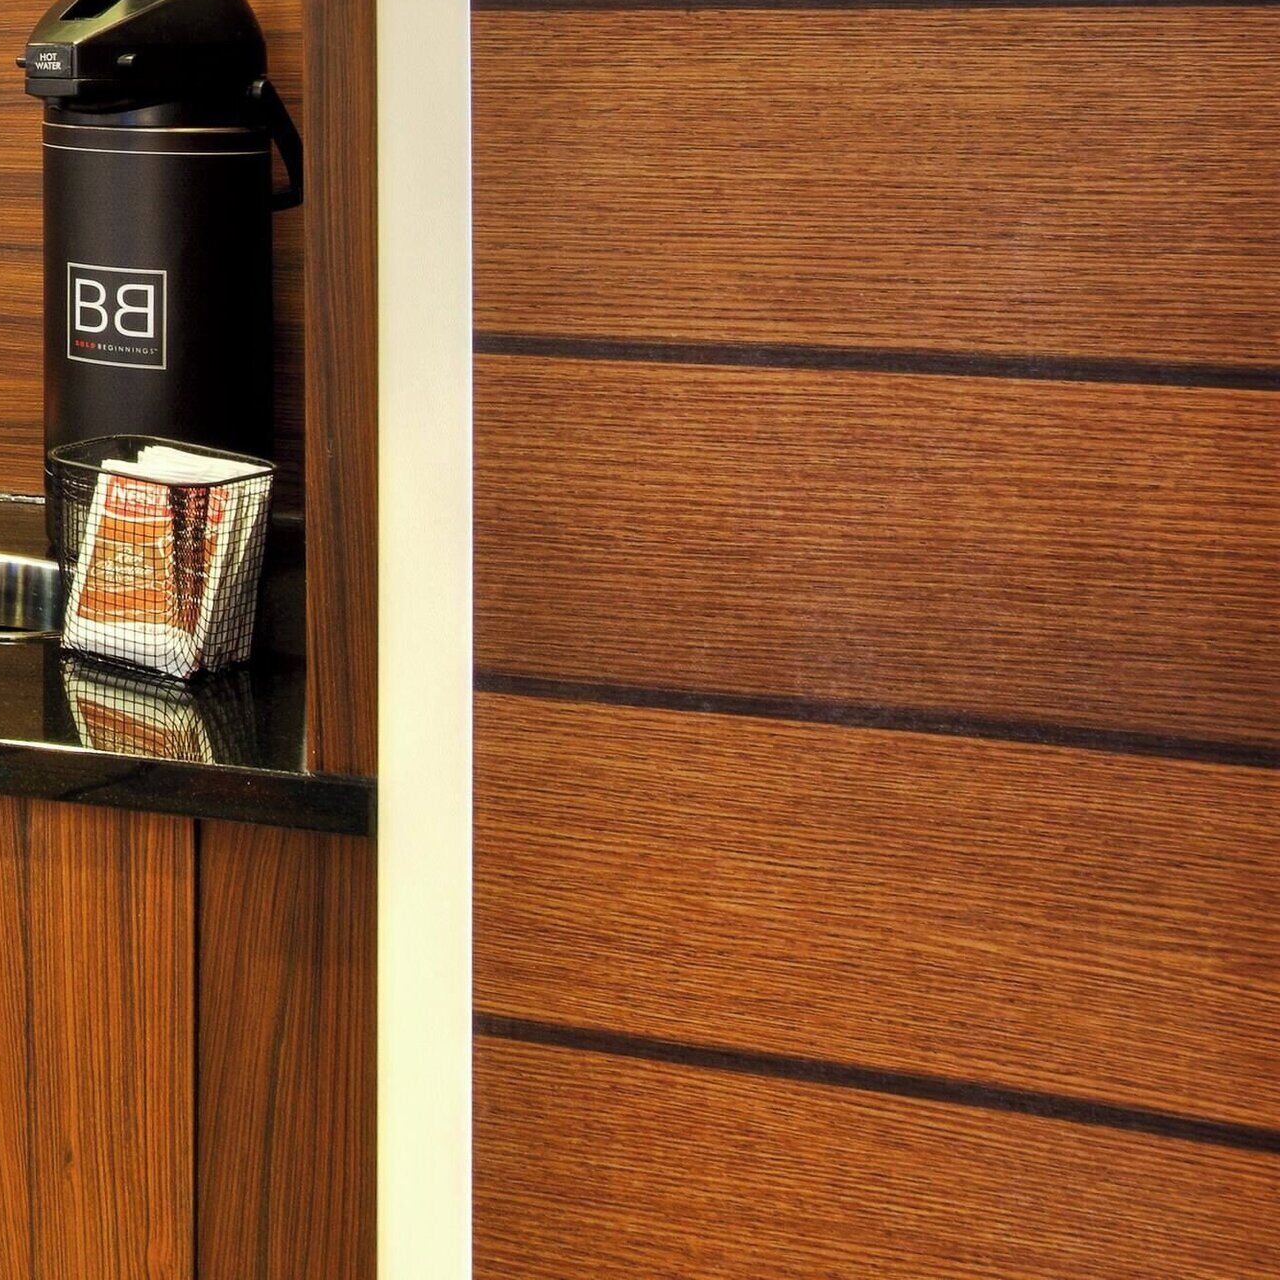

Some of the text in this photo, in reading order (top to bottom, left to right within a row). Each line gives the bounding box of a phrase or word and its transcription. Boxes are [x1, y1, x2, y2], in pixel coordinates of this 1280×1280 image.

[39, 52, 58, 61] HOT
[35, 61, 62, 70] WATER
[75, 278, 154, 338] BB
